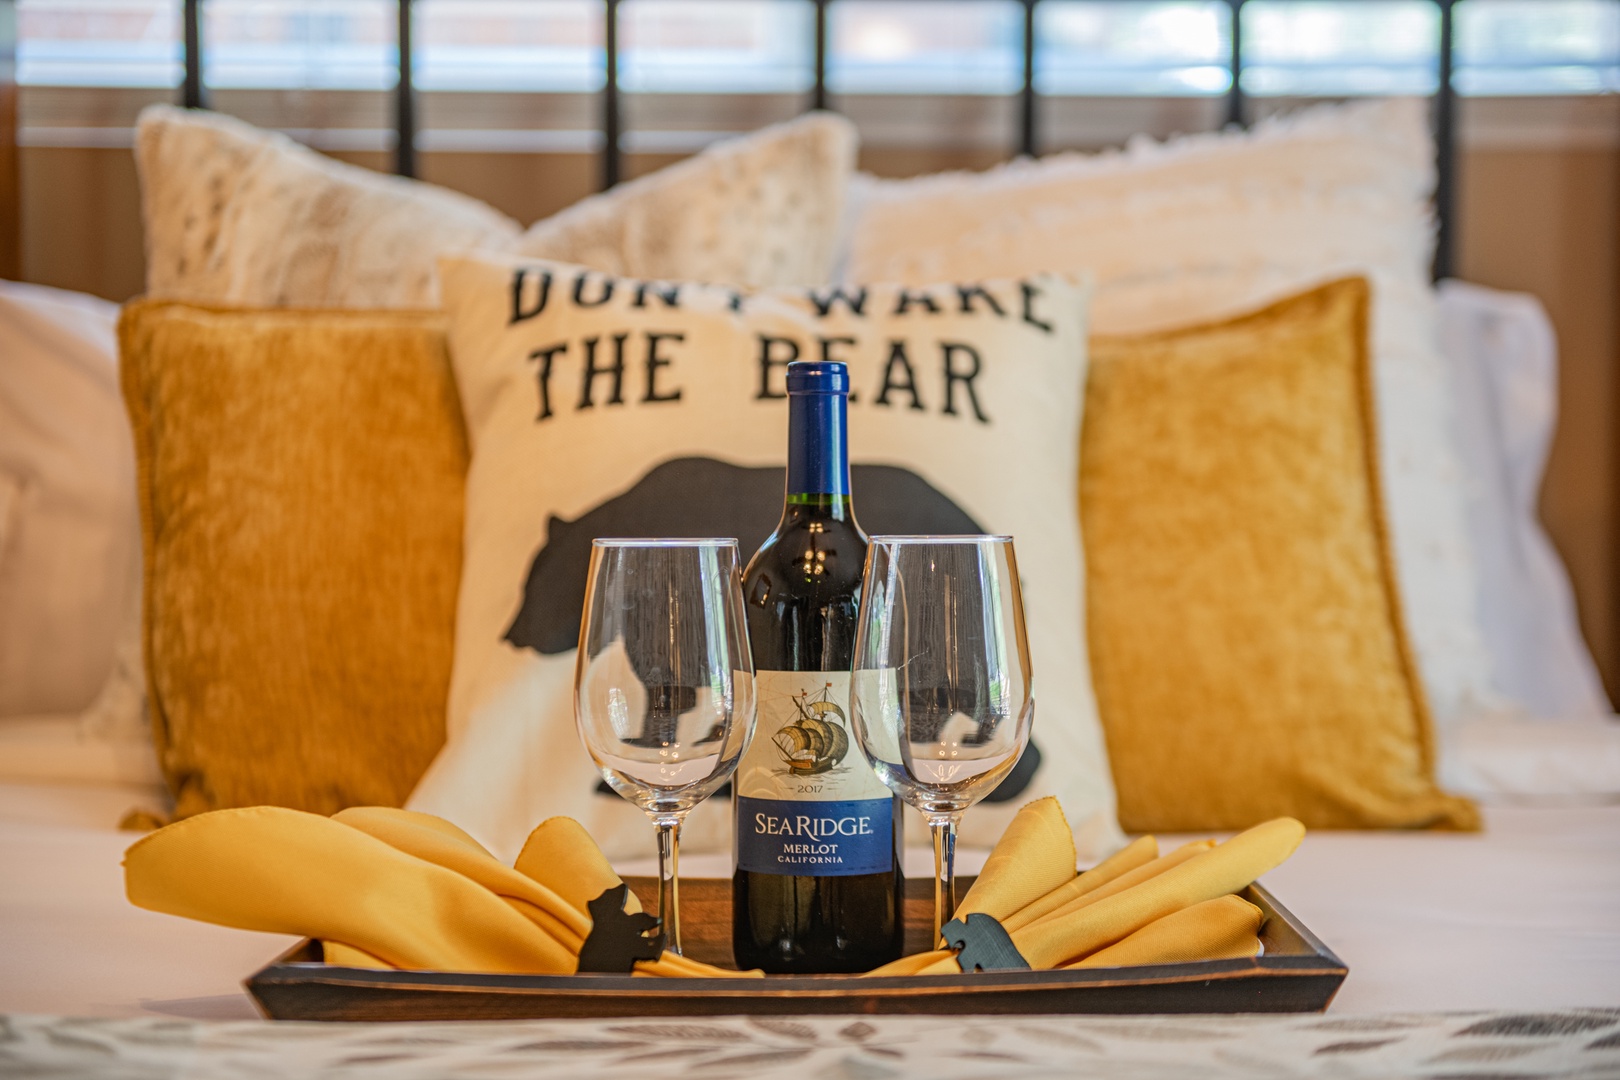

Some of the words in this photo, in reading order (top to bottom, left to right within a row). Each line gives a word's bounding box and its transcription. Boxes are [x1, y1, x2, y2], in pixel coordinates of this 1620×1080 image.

[508, 267, 741, 328] DON
[528, 331, 686, 423] THE
[797, 784, 824, 794] 2017
[783, 843, 839, 855] MERLOT
[777, 855, 843, 864] CALIFORNIA
